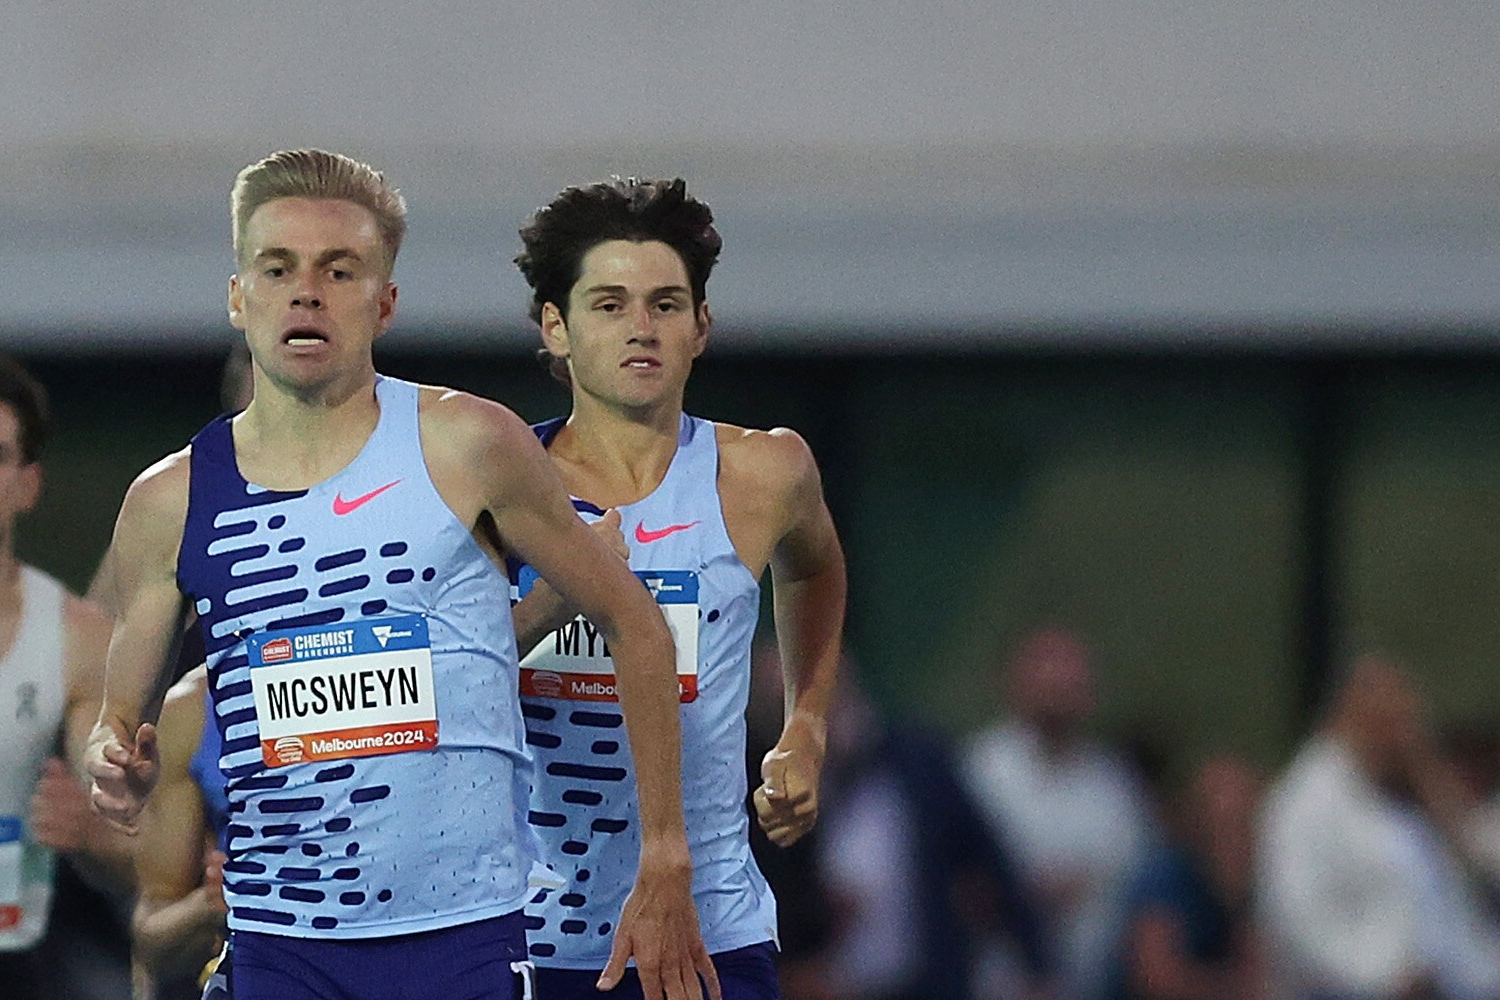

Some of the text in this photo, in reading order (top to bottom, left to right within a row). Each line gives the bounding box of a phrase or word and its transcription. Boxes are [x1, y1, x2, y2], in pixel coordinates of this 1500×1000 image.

[294, 629, 354, 650] CHEMIST
[295, 644, 354, 659] WAREHOUSE
[555, 620, 612, 658] MY
[266, 666, 419, 721] MCSWEYN
[311, 730, 425, 755] Melbourne2024
